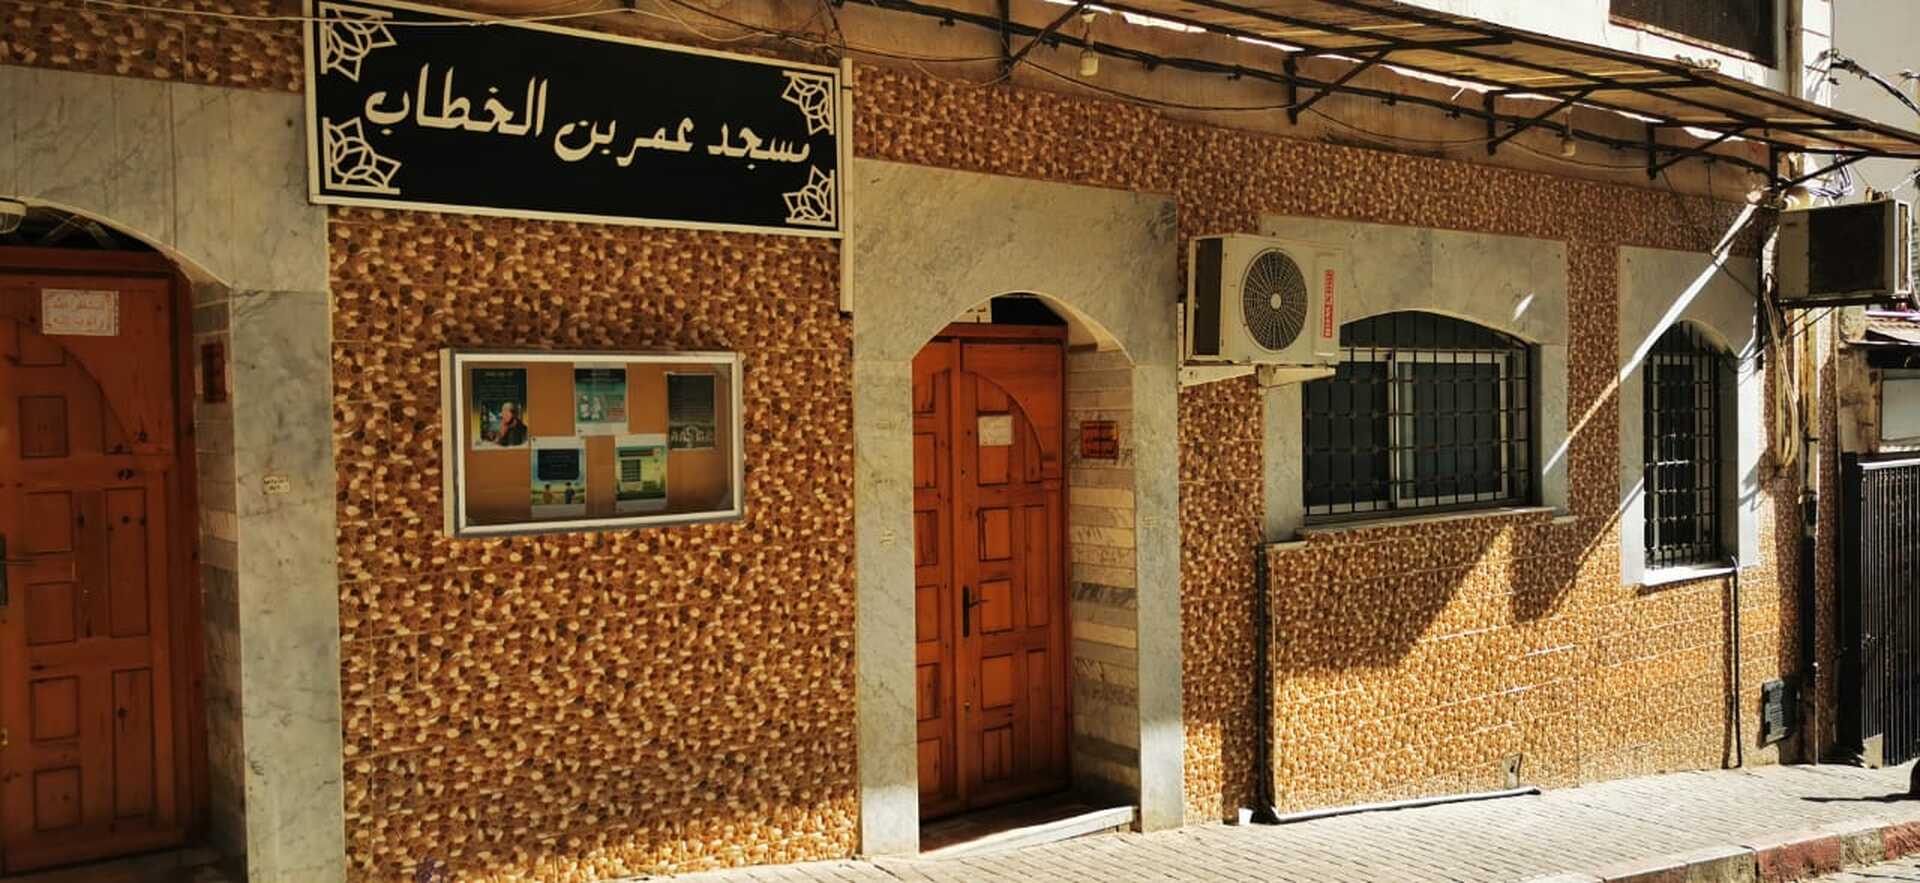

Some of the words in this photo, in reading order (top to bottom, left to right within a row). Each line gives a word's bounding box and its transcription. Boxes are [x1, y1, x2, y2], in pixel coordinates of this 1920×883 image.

[365, 63, 549, 137] الخطاب
[553, 119, 617, 162] بن
[615, 116, 694, 167] عمر
[707, 123, 811, 170] مسجد
